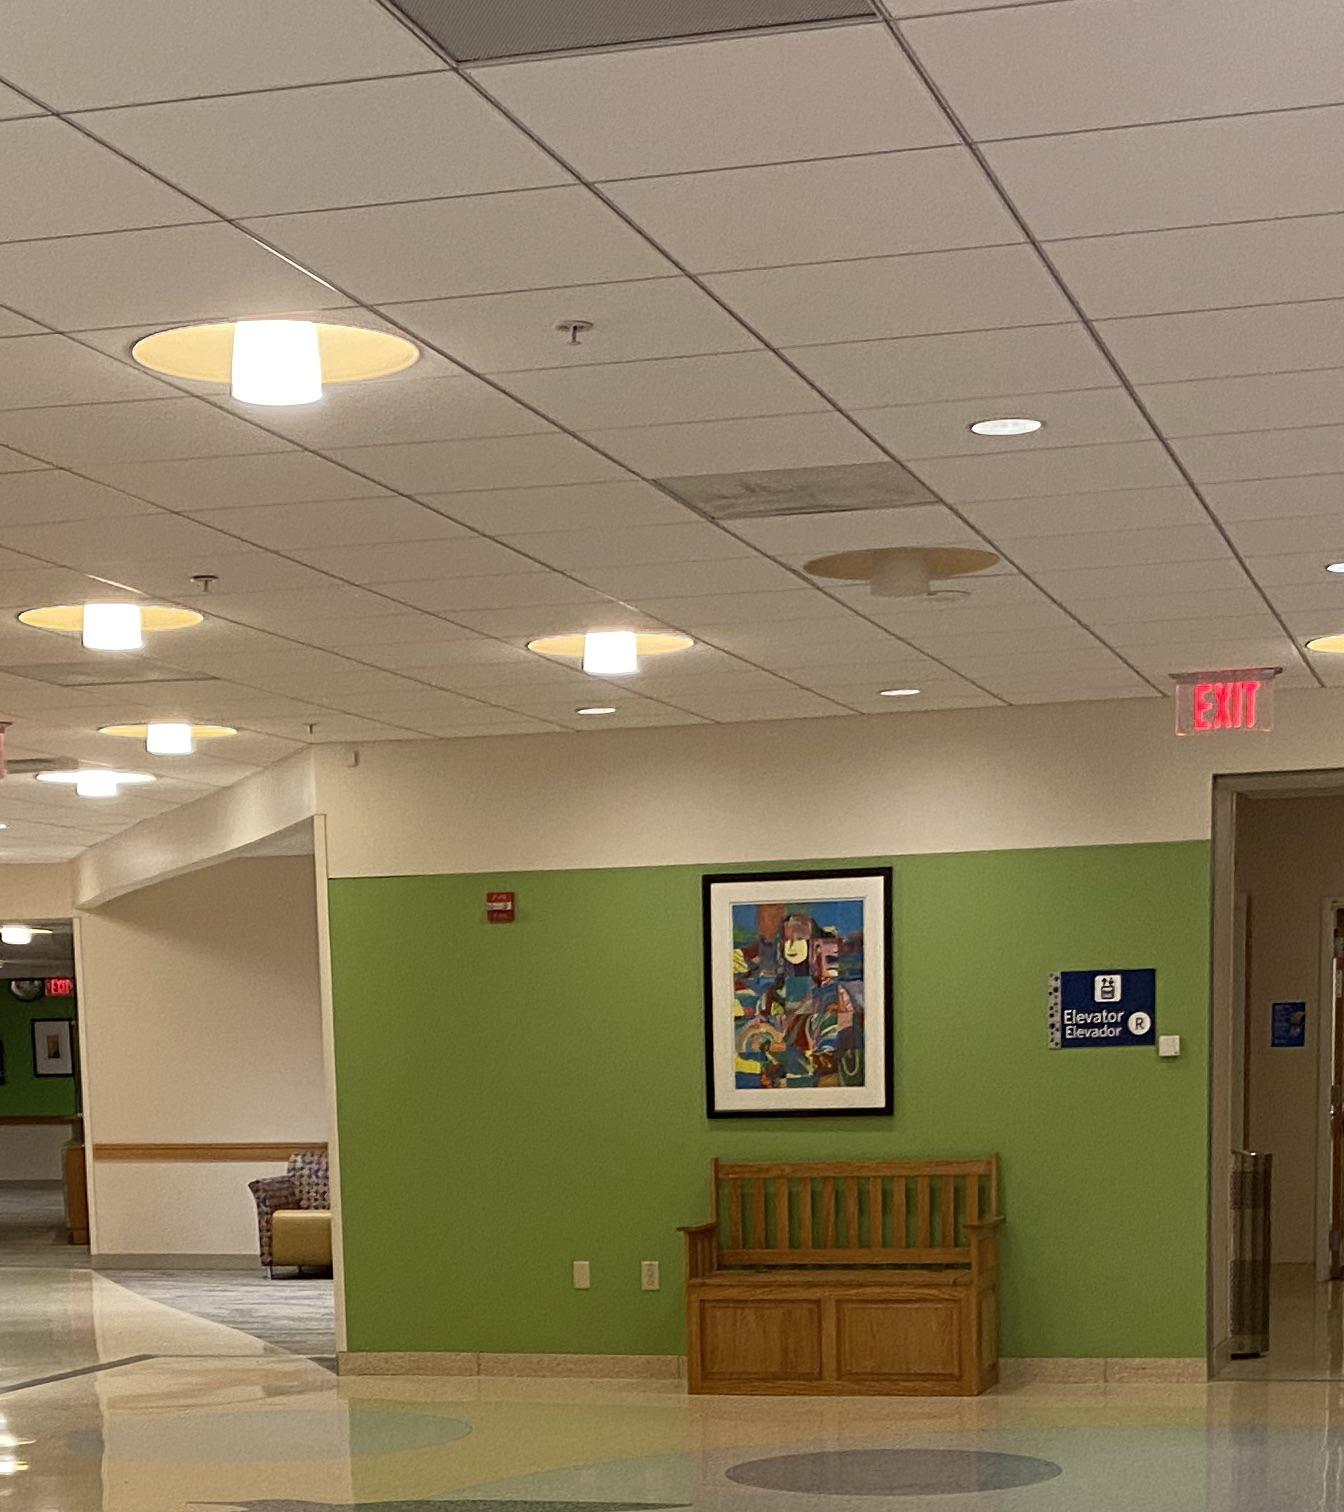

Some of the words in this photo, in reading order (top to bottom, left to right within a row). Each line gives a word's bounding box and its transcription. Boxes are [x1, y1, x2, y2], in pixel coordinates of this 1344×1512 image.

[1194, 681, 1260, 730] EXIT
[1063, 1009, 1125, 1024] Elevator
[1134, 1017, 1145, 1030] R
[1065, 1025, 1123, 1039] Elevador
